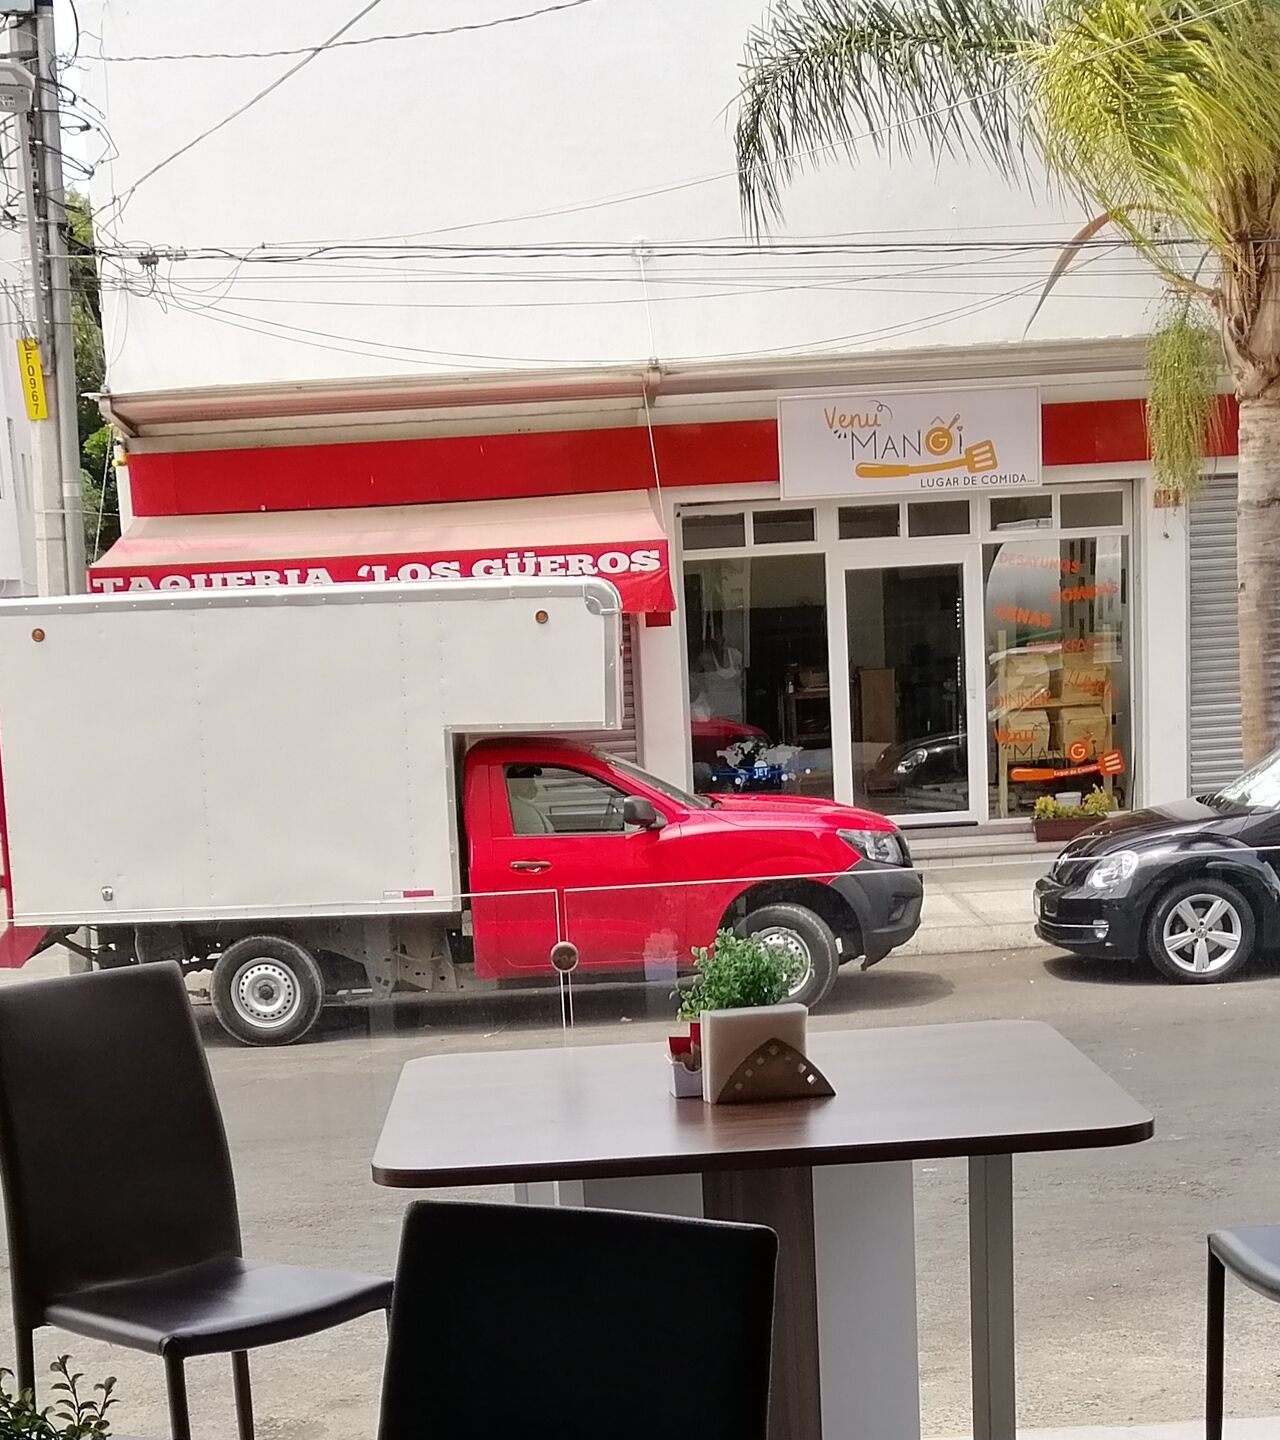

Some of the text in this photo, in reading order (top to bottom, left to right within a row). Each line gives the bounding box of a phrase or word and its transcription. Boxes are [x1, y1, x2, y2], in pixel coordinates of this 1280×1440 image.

[823, 402, 886, 431] Venu
[920, 476, 960, 488] LUGAR
[962, 475, 978, 486] DE
[471, 549, 661, 578] GÜEROS
[998, 551, 1081, 574] DESAYUNOS
[992, 689, 1051, 708] DINNER
